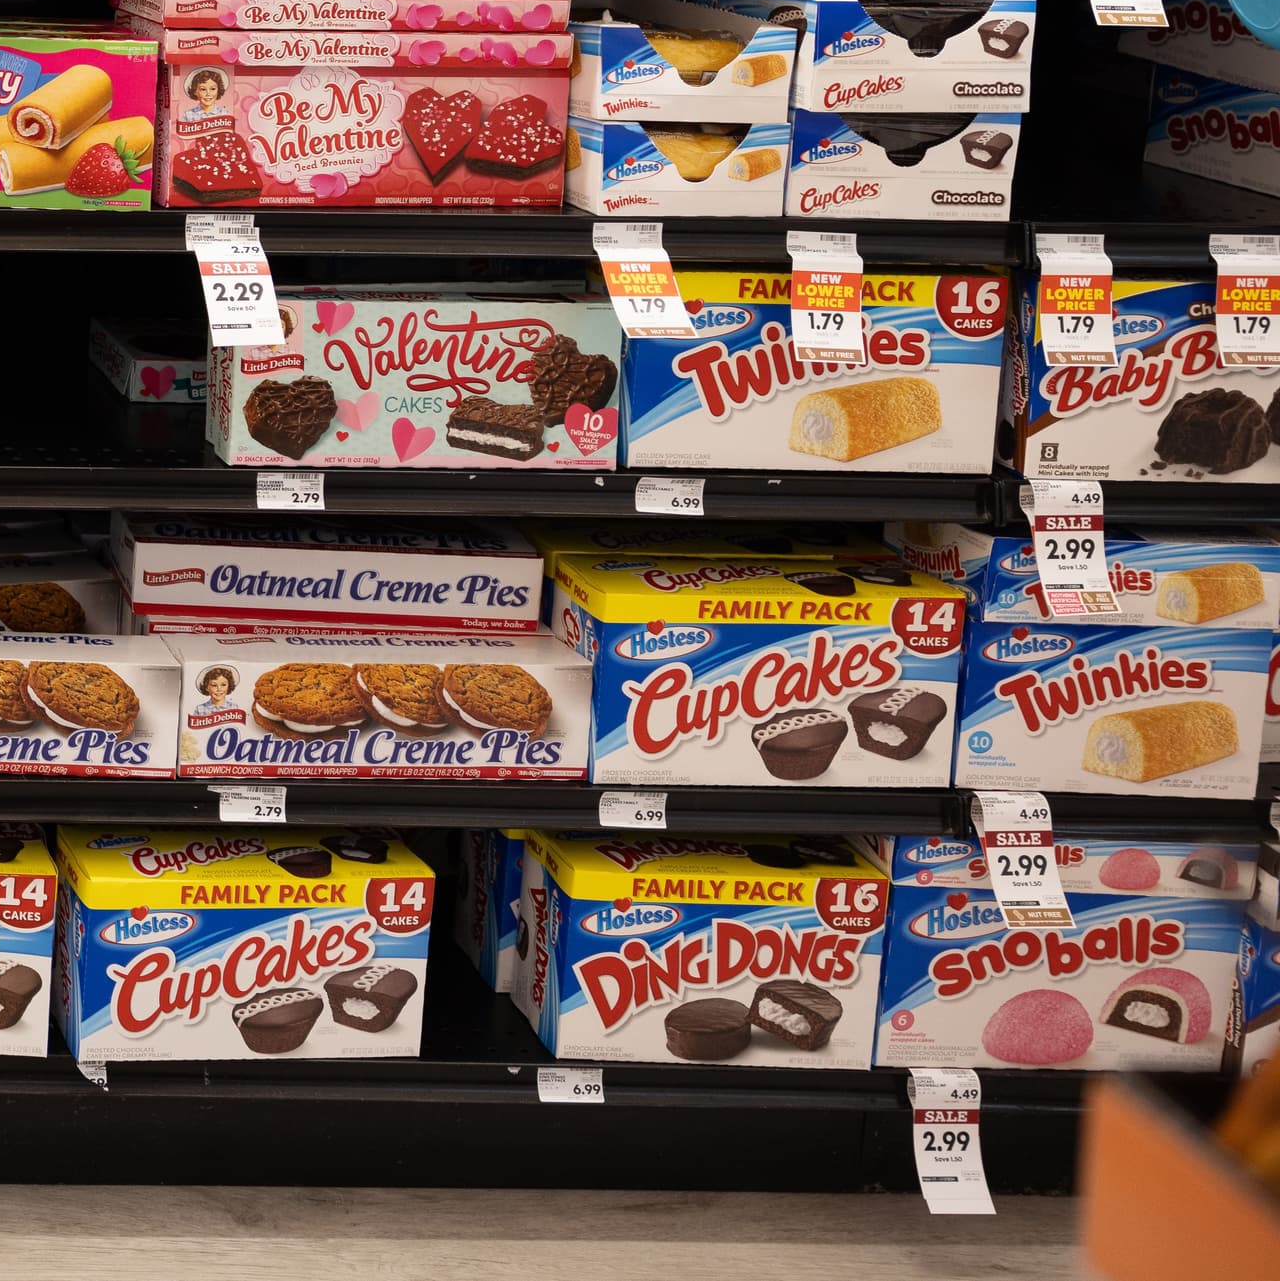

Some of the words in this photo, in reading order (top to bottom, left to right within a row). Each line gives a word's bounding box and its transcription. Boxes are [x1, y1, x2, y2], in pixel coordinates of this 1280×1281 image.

[832, 36, 881, 56] Hostess
[824, 75, 905, 109] CupCakes
[955, 83, 1022, 97] Chocolate
[262, 91, 313, 126] Be
[321, 80, 383, 121] My
[603, 99, 649, 116] Twinkies
[253, 123, 403, 168] Valentine
[811, 274, 841, 284] NEW
[797, 285, 854, 298] LOWER
[950, 281, 1000, 315] 16
[808, 298, 845, 308] PRICE
[808, 313, 844, 330] 1.79
[954, 317, 993, 329] CAKES
[1072, 493, 1100, 503] 4.49
[1045, 539, 1095, 559] 2.99
[209, 565, 344, 598] Oatmeal
[351, 569, 449, 603] Creme
[455, 574, 529, 607] Pies
[999, 653, 1209, 730] Twinkies
[716, 921, 861, 985] DONGS
[109, 916, 375, 1034] CupCakes
[573, 1084, 601, 1095] 6.99
[924, 1111, 968, 1124] SALE
[924, 1132, 971, 1154] 2.99
